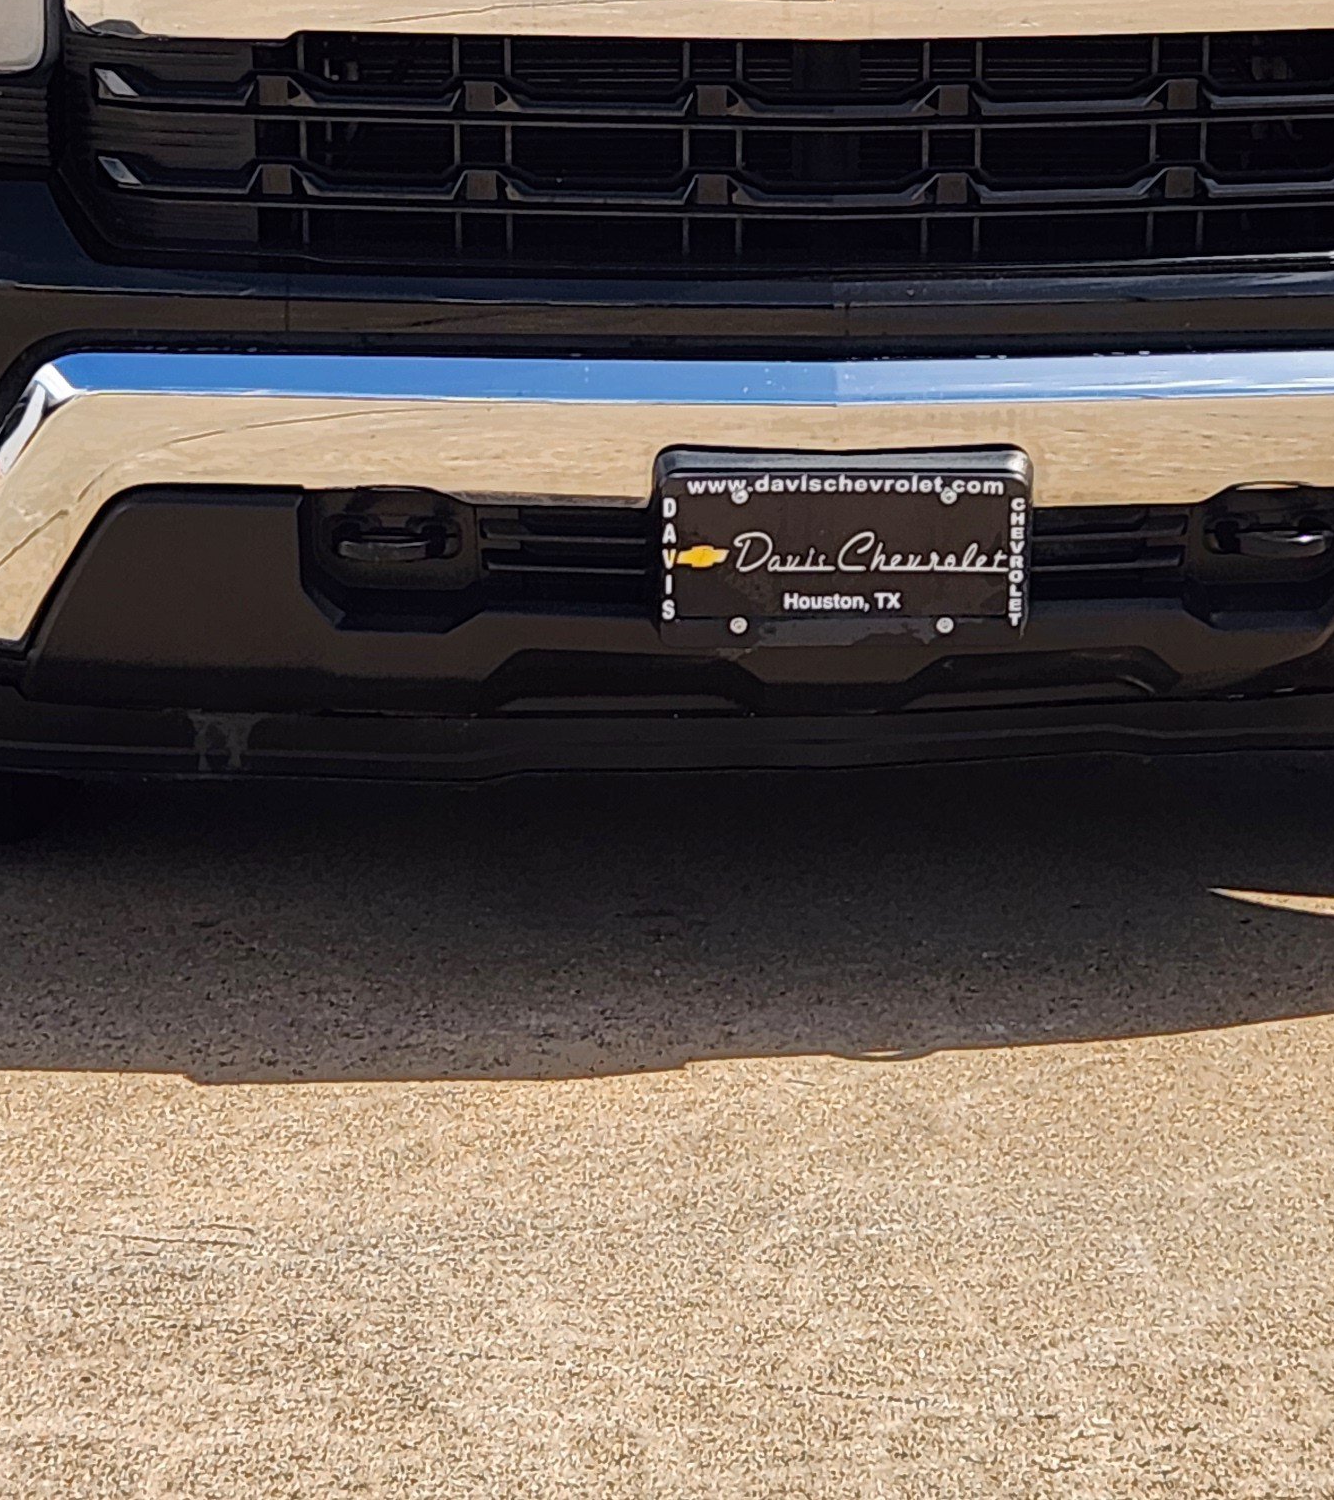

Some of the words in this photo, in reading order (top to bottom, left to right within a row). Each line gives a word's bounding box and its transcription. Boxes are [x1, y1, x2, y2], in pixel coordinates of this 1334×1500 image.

[687, 473, 1004, 495] www.davischevrolet.com
[662, 497, 677, 620] DAVIS
[733, 531, 836, 573] Davis
[837, 531, 1009, 573] Chevrolet
[1008, 497, 1026, 627] CHEVROLET
[783, 592, 870, 612] Houston,
[874, 592, 901, 610] TX
